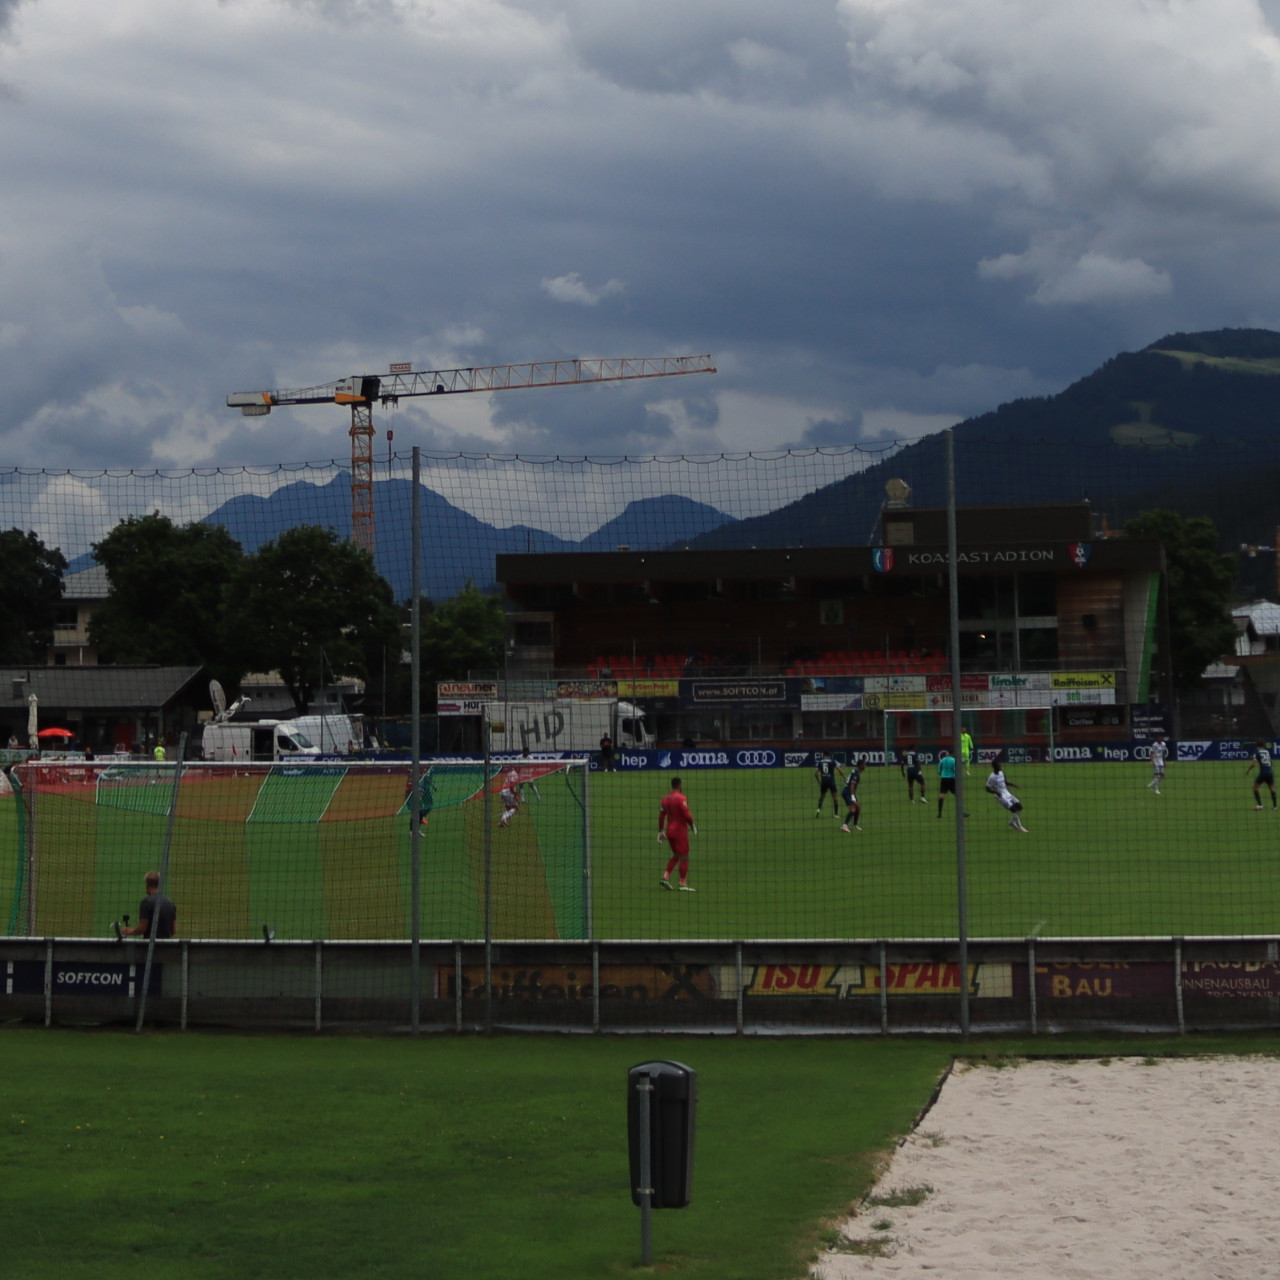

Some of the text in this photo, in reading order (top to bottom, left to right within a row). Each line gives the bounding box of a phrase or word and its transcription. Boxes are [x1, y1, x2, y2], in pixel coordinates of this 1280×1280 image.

[1054, 677, 1100, 687] Raiffeisen
[520, 710, 564, 749] HD
[1045, 746, 1092, 761] joma
[1104, 746, 1129, 760] hep
[1177, 744, 1204, 758] SAP
[1220, 742, 1240, 751] pre
[621, 750, 647, 767] hep
[680, 751, 729, 768] joma
[785, 754, 803, 766] SAP
[978, 749, 998, 761] SAP
[1007, 755, 1032, 763] zero
[1220, 751, 1248, 759] zero
[57, 971, 123, 985] SOFTCON
[1181, 978, 1270, 990] INNENAUSBAU
[1052, 975, 1113, 997] BAU
